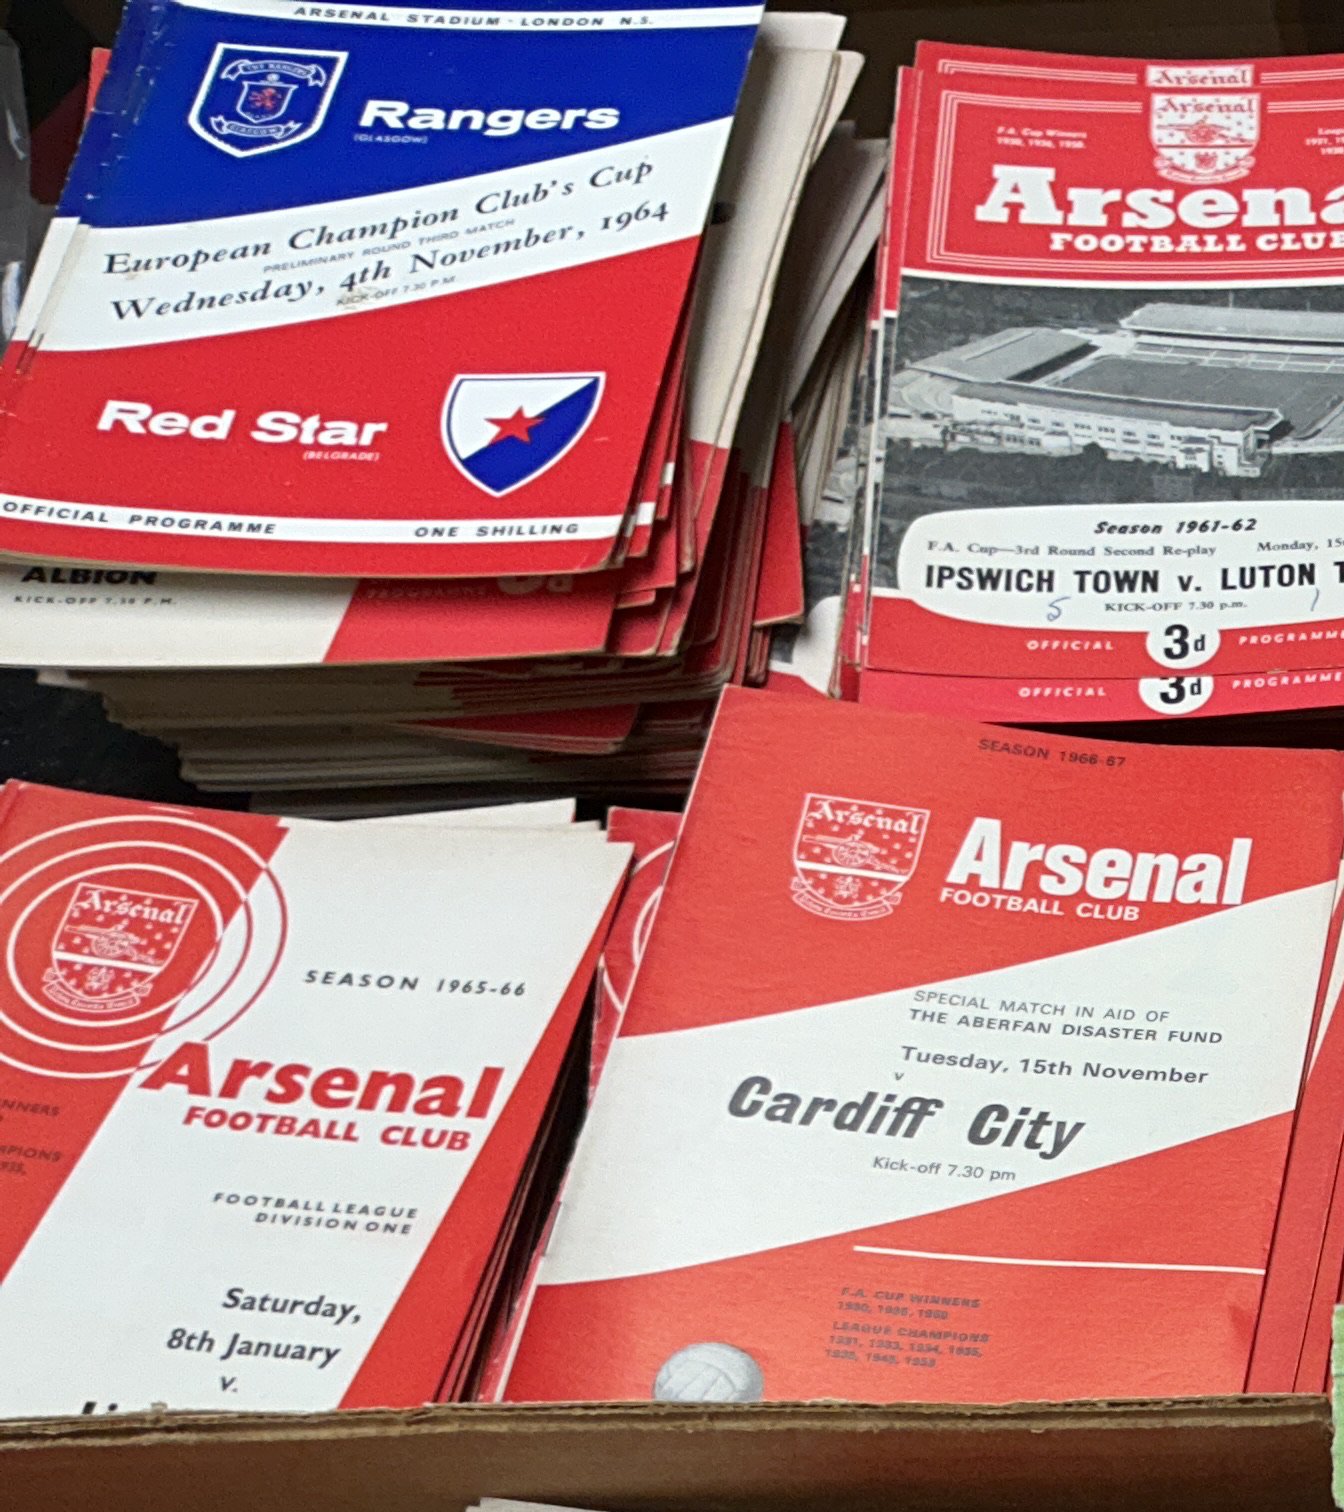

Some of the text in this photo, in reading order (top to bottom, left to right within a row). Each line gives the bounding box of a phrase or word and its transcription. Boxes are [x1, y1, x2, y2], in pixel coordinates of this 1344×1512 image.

[294, 6, 604, 27] ARSENAL STADIUM LONDON
[358, 99, 621, 137] Rangers
[103, 158, 655, 280] European Champion Club's Cup
[1049, 230, 1247, 254] FOOTBALL
[111, 201, 670, 323] Wednesday, 4th November, 1964
[97, 400, 389, 447] Red Star
[2, 500, 277, 536] OFFICIAL PROGRAMME
[414, 522, 580, 539] ONE SHILLING
[1093, 518, 1258, 537] Season 1961-62
[925, 564, 1055, 594] IPSWICH
[1075, 569, 1160, 594] TOWN
[1220, 563, 1317, 591] LUTON
[1026, 639, 1114, 652] OFFICIAL
[1163, 622, 1207, 660] 3d
[945, 816, 1253, 906] Arsenal
[939, 886, 1140, 922] FOOTBALL CLUB
[304, 969, 528, 998] SEASON 1965-66
[913, 988, 1067, 1017] SPECIAL MATCH
[909, 1007, 1224, 1045] THE ABERFAN DISASTER FUND
[136, 1040, 506, 1120] Arsenal
[900, 1045, 1209, 1086] Tuesday, 15th November
[182, 1105, 472, 1151] FOOTBALL CLUB
[727, 1074, 1087, 1161] Cardiff City
[871, 1155, 984, 1180] Kick-off 7.30
[221, 1286, 363, 1326] Saturday,
[166, 1326, 342, 1370] 8th January
